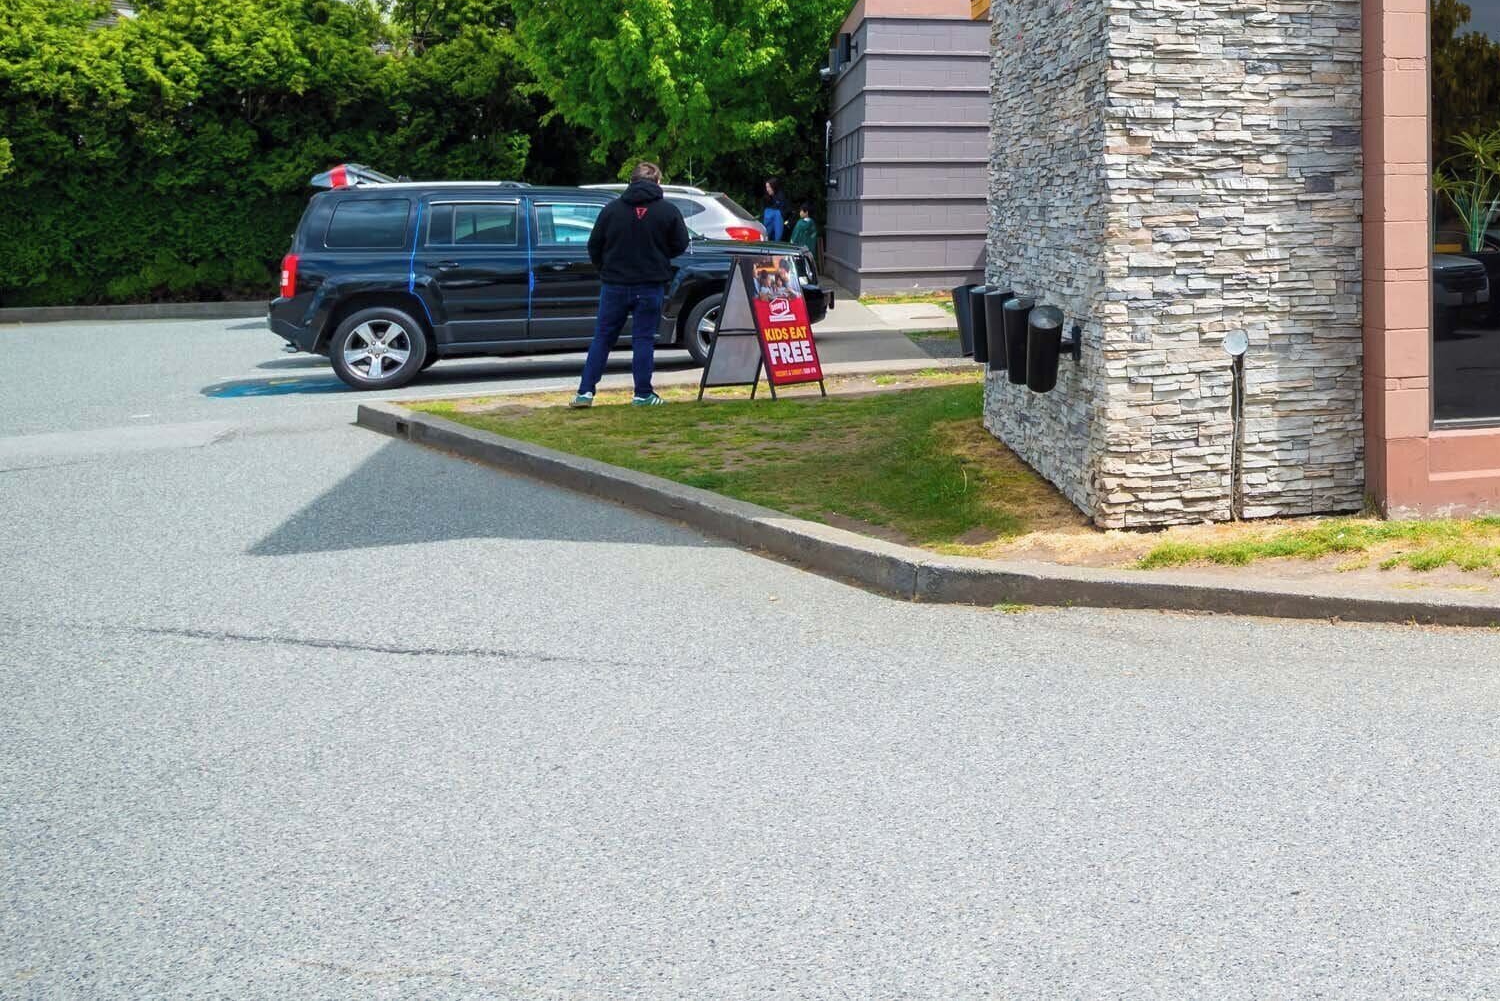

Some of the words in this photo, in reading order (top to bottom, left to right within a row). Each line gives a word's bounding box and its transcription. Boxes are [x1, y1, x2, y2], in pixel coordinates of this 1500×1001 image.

[764, 327, 789, 341] KIDS
[789, 326, 807, 339] EAT
[768, 340, 814, 365] FREE
